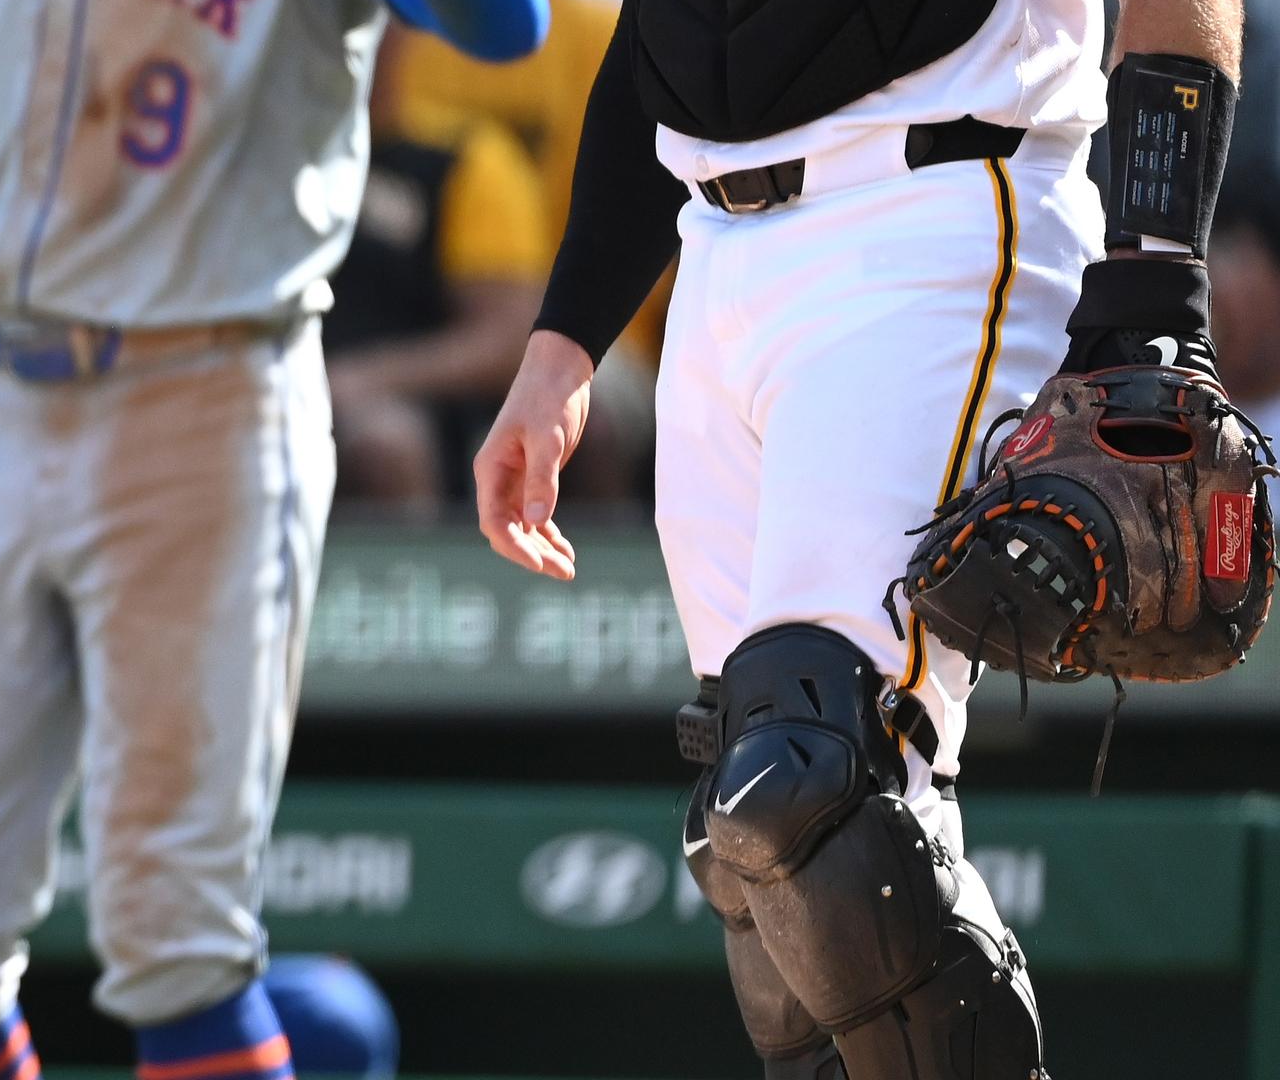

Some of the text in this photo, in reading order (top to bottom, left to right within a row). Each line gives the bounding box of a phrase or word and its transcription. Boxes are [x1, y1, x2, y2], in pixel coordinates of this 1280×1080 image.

[120, 56, 192, 169] 9
[1174, 85, 1199, 110] P
[1220, 501, 1239, 572] Rawlings
